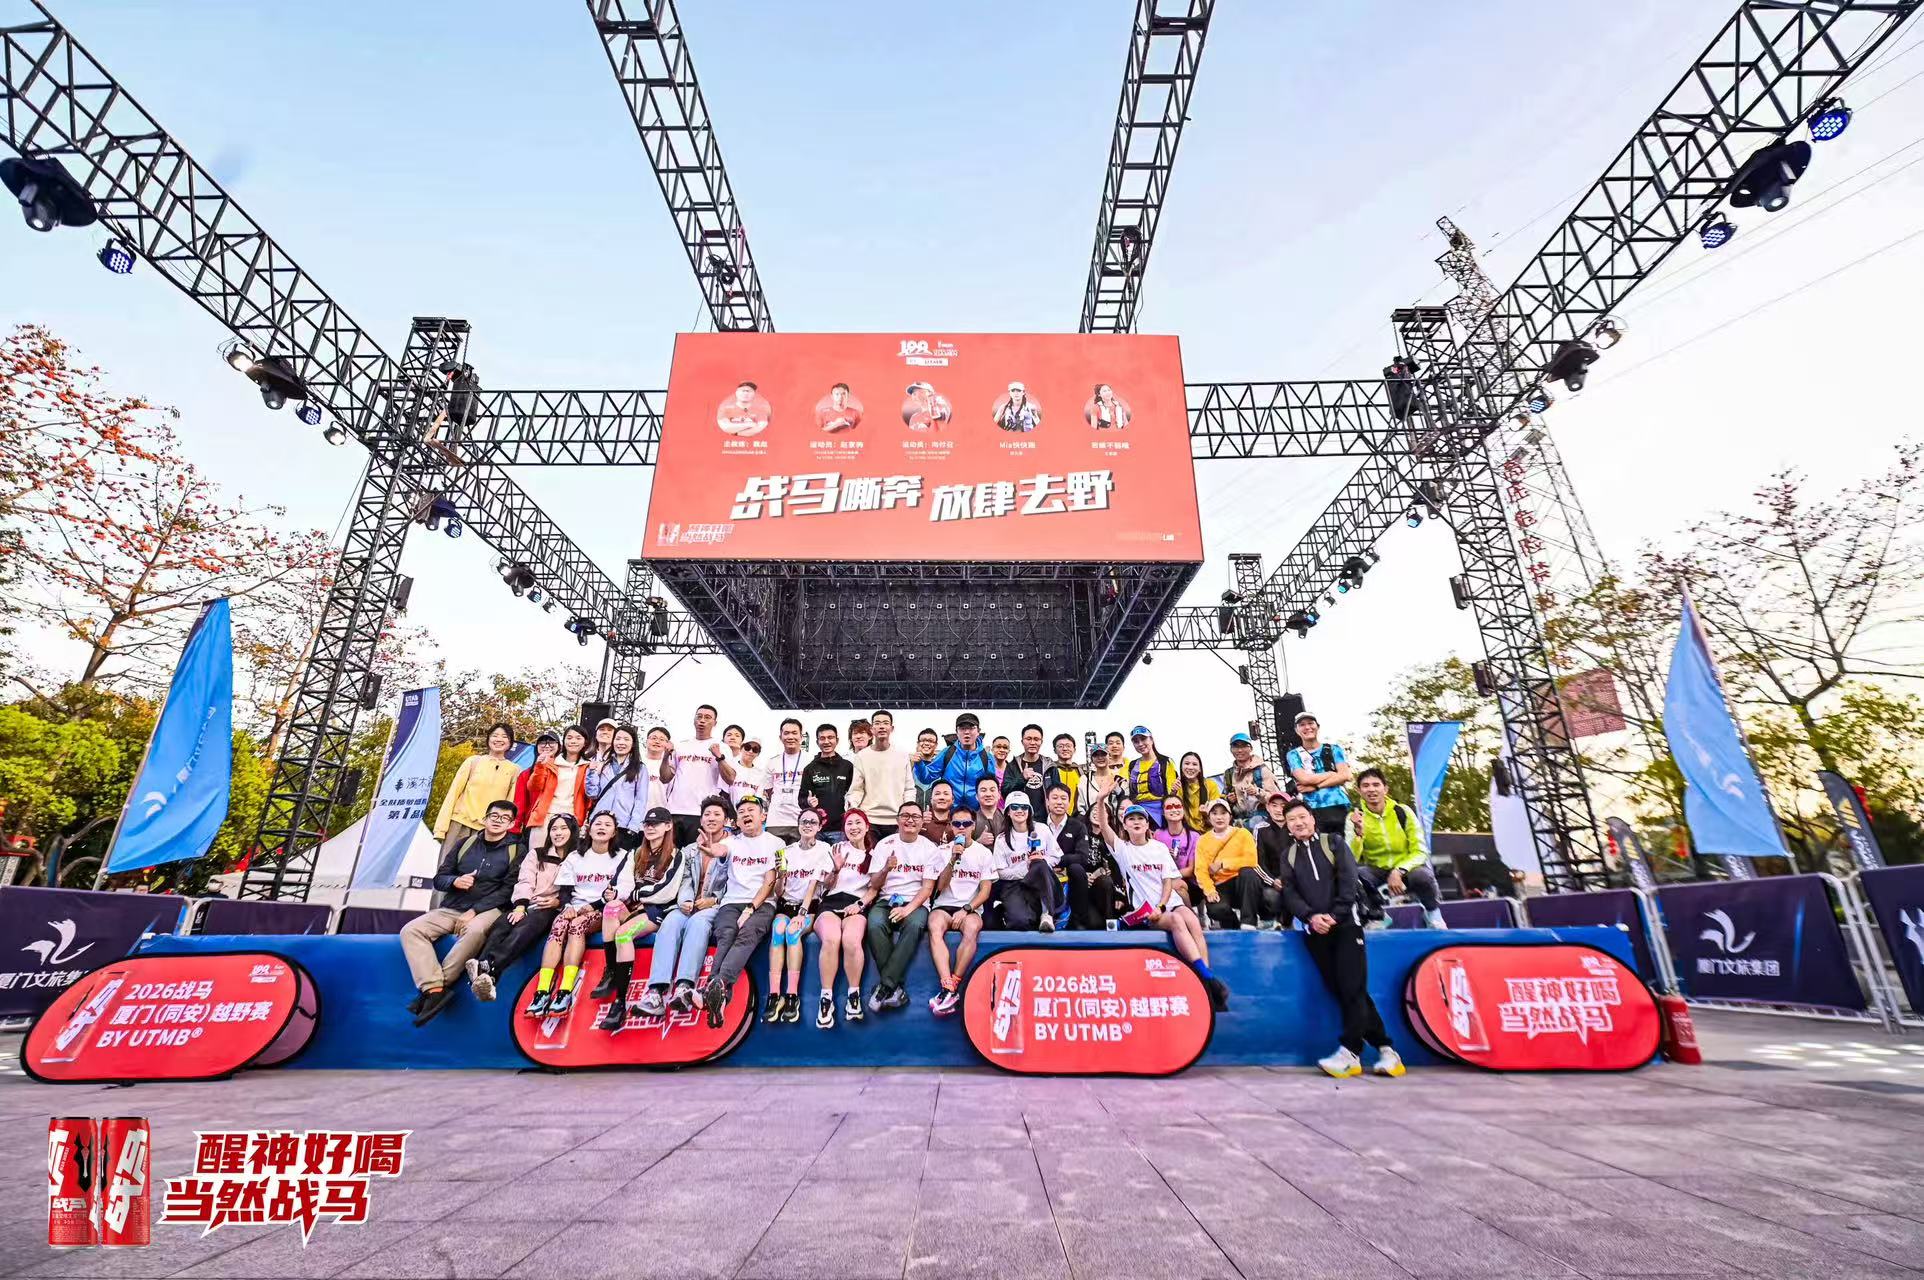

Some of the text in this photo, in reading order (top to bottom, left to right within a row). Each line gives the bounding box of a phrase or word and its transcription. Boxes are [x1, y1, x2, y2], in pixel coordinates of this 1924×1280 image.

[730, 469, 1114, 521] 战马嘶奔 放肆去野
[1697, 958, 1780, 977] 厦门文旅集团
[0, 970, 89, 990] 厦门文旅集
[125, 980, 213, 1000] 2026战马
[1032, 975, 1117, 994] 2026战马
[1505, 978, 1621, 1005] 醒神好喝
[1035, 1023, 1061, 1040] BY
[1498, 1003, 1613, 1044] 当然战马
[96, 1031, 131, 1048] BY
